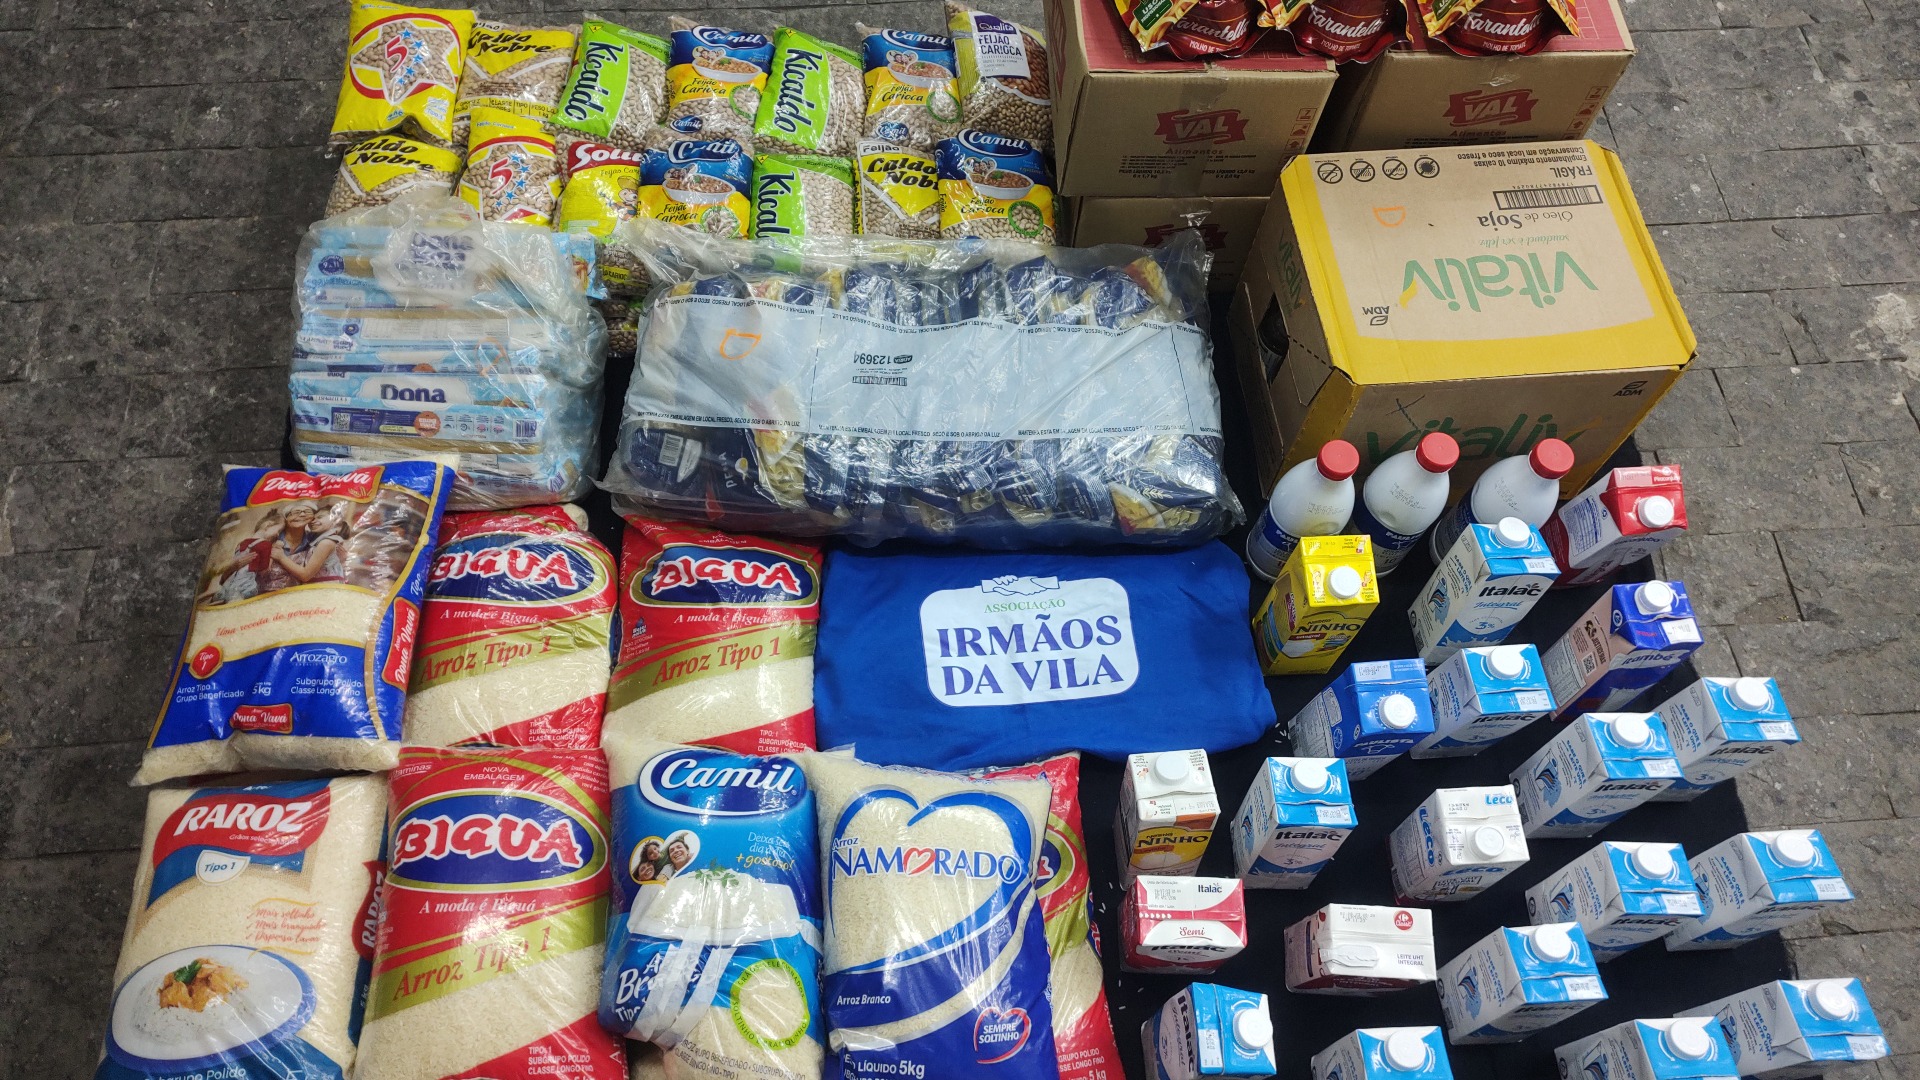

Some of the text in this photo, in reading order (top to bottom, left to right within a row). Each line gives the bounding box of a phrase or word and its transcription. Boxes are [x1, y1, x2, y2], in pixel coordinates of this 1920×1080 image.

[1176, 17, 1250, 43] Tarantella
[1309, 10, 1385, 39] Tarantella
[468, 31, 533, 49] Caldo
[893, 29, 949, 46] Camil
[979, 34, 1010, 45] FEIJÃO
[1322, 39, 1338, 49] MOLHO
[476, 42, 552, 57] Nobre
[981, 44, 1023, 57] CARIOCA
[1190, 40, 1207, 51] MOLHO
[1483, 41, 1500, 50] MOLHO
[385, 35, 408, 74] 5
[565, 41, 625, 122] Kicaldo
[692, 77, 718, 86] Feijão
[681, 84, 727, 95] Carioca
[774, 48, 824, 134] Kicaldo
[882, 92, 923, 102] Carioca
[1464, 97, 1517, 121] VAL
[674, 118, 700, 129] Camil
[1174, 116, 1229, 139] VAL
[1450, 129, 1507, 137] Alimentos
[969, 131, 1027, 149] Camil
[863, 144, 900, 153] Feijão
[1488, 151, 1505, 159] seco
[1508, 150, 1525, 158] local
[1538, 147, 1584, 157] Conservação
[351, 152, 436, 171] Nobre
[1458, 152, 1482, 160] fresco
[1473, 154, 1588, 168] Empilhamento máximo caixas
[867, 157, 938, 174] Caldo
[488, 156, 514, 197] 5
[1549, 165, 1593, 180] FRÁGIL
[664, 202, 688, 213] Feijão
[1477, 211, 1574, 232] Óleo de Soja
[1402, 251, 1599, 313] vitaliv
[1362, 305, 1390, 316] ADM
[853, 350, 892, 365] 123694
[380, 383, 447, 403] Dona
[1613, 389, 1645, 397] ADM
[431, 547, 578, 591] BIGUA
[651, 556, 802, 597] BIGUA
[1479, 584, 1542, 598] Italac
[984, 598, 1066, 614] ASSOCIAÇÃO
[440, 609, 450, 620] A
[674, 614, 684, 624] A
[686, 612, 720, 623] moda
[215, 607, 336, 638] Uma receita de gerações!
[1297, 622, 1361, 634] NINHO
[936, 613, 1122, 658] IRMÃOS
[394, 608, 417, 684] Dona Vavá
[198, 652, 215, 662] Tipo
[290, 650, 348, 665] Arrozagro
[421, 635, 551, 681] Arroz Tipo 1
[652, 636, 781, 687] Arroz Tipo 1
[941, 653, 1124, 696] DA VILA
[177, 683, 211, 695] Arroz Tipo
[295, 677, 335, 688] Subgrupo
[176, 689, 245, 704] Grupo Beneficiado
[251, 684, 272, 697] 5kg
[290, 686, 341, 696] Classe Longo
[233, 711, 288, 723] Dona Vavá
[759, 737, 789, 747] SUBGRUPO
[757, 745, 780, 753] CLASSE
[1709, 744, 1775, 756] Italac
[463, 773, 525, 781] EMBALAGEM
[661, 758, 794, 793] Camil
[1595, 781, 1665, 793] Italac
[1485, 794, 1513, 805] Leco
[173, 801, 313, 837] RAROZ
[229, 833, 249, 841] Grãos
[392, 813, 584, 868] BIGUA
[748, 831, 775, 844] Deixa
[833, 836, 859, 849] Arroz
[1138, 834, 1208, 848] NINHO
[1276, 831, 1342, 841] Italac
[749, 843, 764, 854] dia
[204, 863, 230, 873] Tipo
[831, 846, 1022, 884] NAMORADO
[1197, 882, 1223, 894] Italac
[418, 899, 431, 914] A
[435, 898, 475, 913] moda
[478, 897, 487, 912] é
[255, 908, 278, 919] Mais
[1611, 915, 1681, 927] Italac
[1179, 926, 1206, 937] Semi
[393, 959, 465, 1002] Arroz
[540, 926, 551, 952] 1
[737, 960, 762, 987] GRÃOS
[836, 993, 891, 1005] Arroz Branco
[733, 1000, 756, 1041] SOLTINHO
[983, 1022, 1018, 1034] SEMPRE
[1178, 995, 1195, 1072] Italac
[978, 1032, 1020, 1045] SOLTINHO
[1079, 1048, 1100, 1059] POLIDO
[857, 1058, 897, 1075] LÍQUIDO
[899, 1059, 925, 1079] 5kg
[1072, 1056, 1105, 1071] LONGO FINO
[206, 1067, 247, 1080] Polido
[528, 1066, 556, 1075] CLASSE
